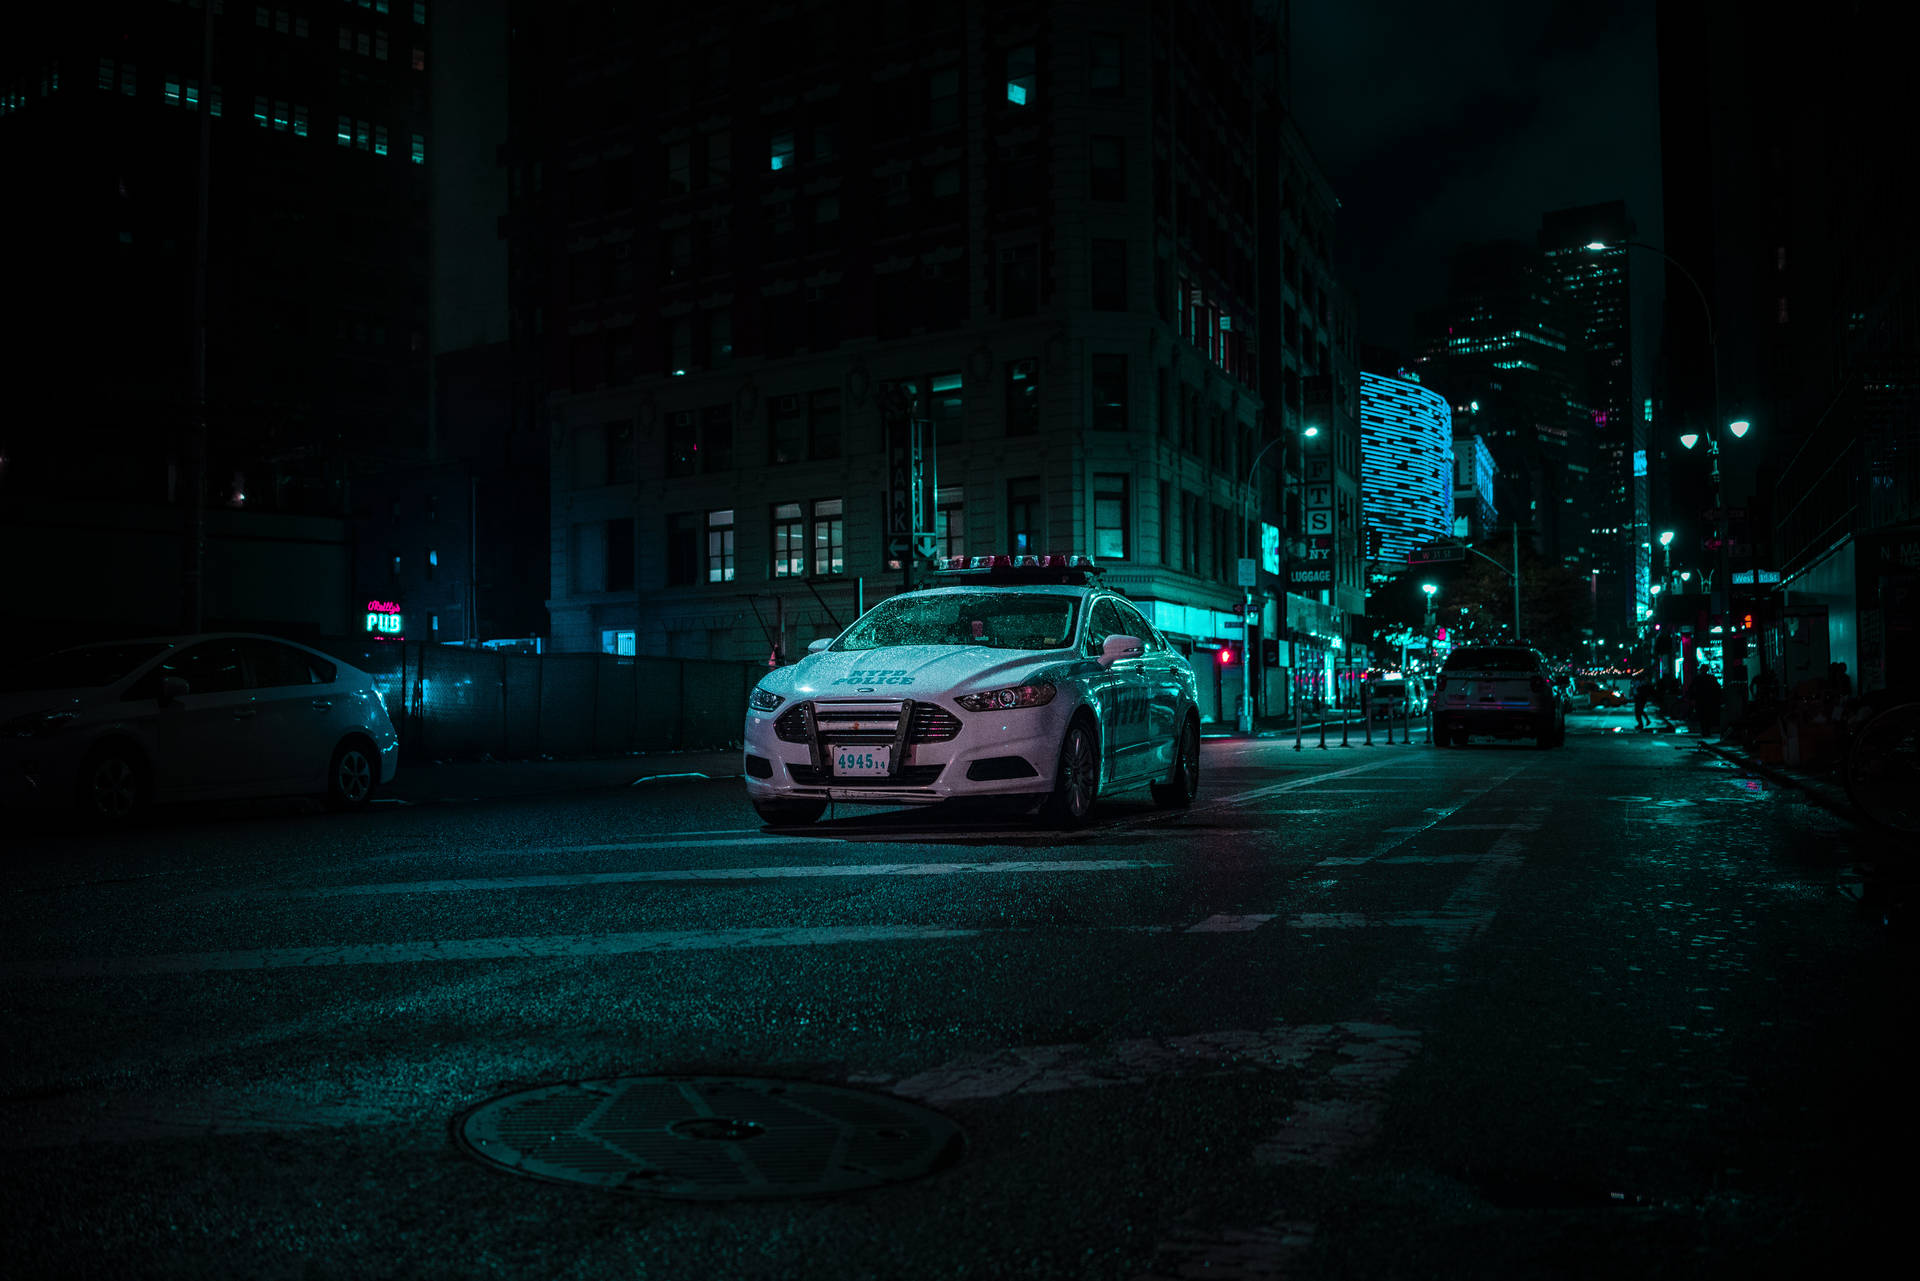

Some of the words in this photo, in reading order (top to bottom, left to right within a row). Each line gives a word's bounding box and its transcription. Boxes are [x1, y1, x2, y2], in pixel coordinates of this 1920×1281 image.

[1308, 548, 1331, 560] NY
[1290, 570, 1332, 582] LUGGAGE
[367, 612, 401, 632] PUB
[849, 669, 908, 677] NYPD
[831, 676, 916, 685] POLICE
[838, 753, 873, 769] 4945
[874, 761, 885, 769] 14
